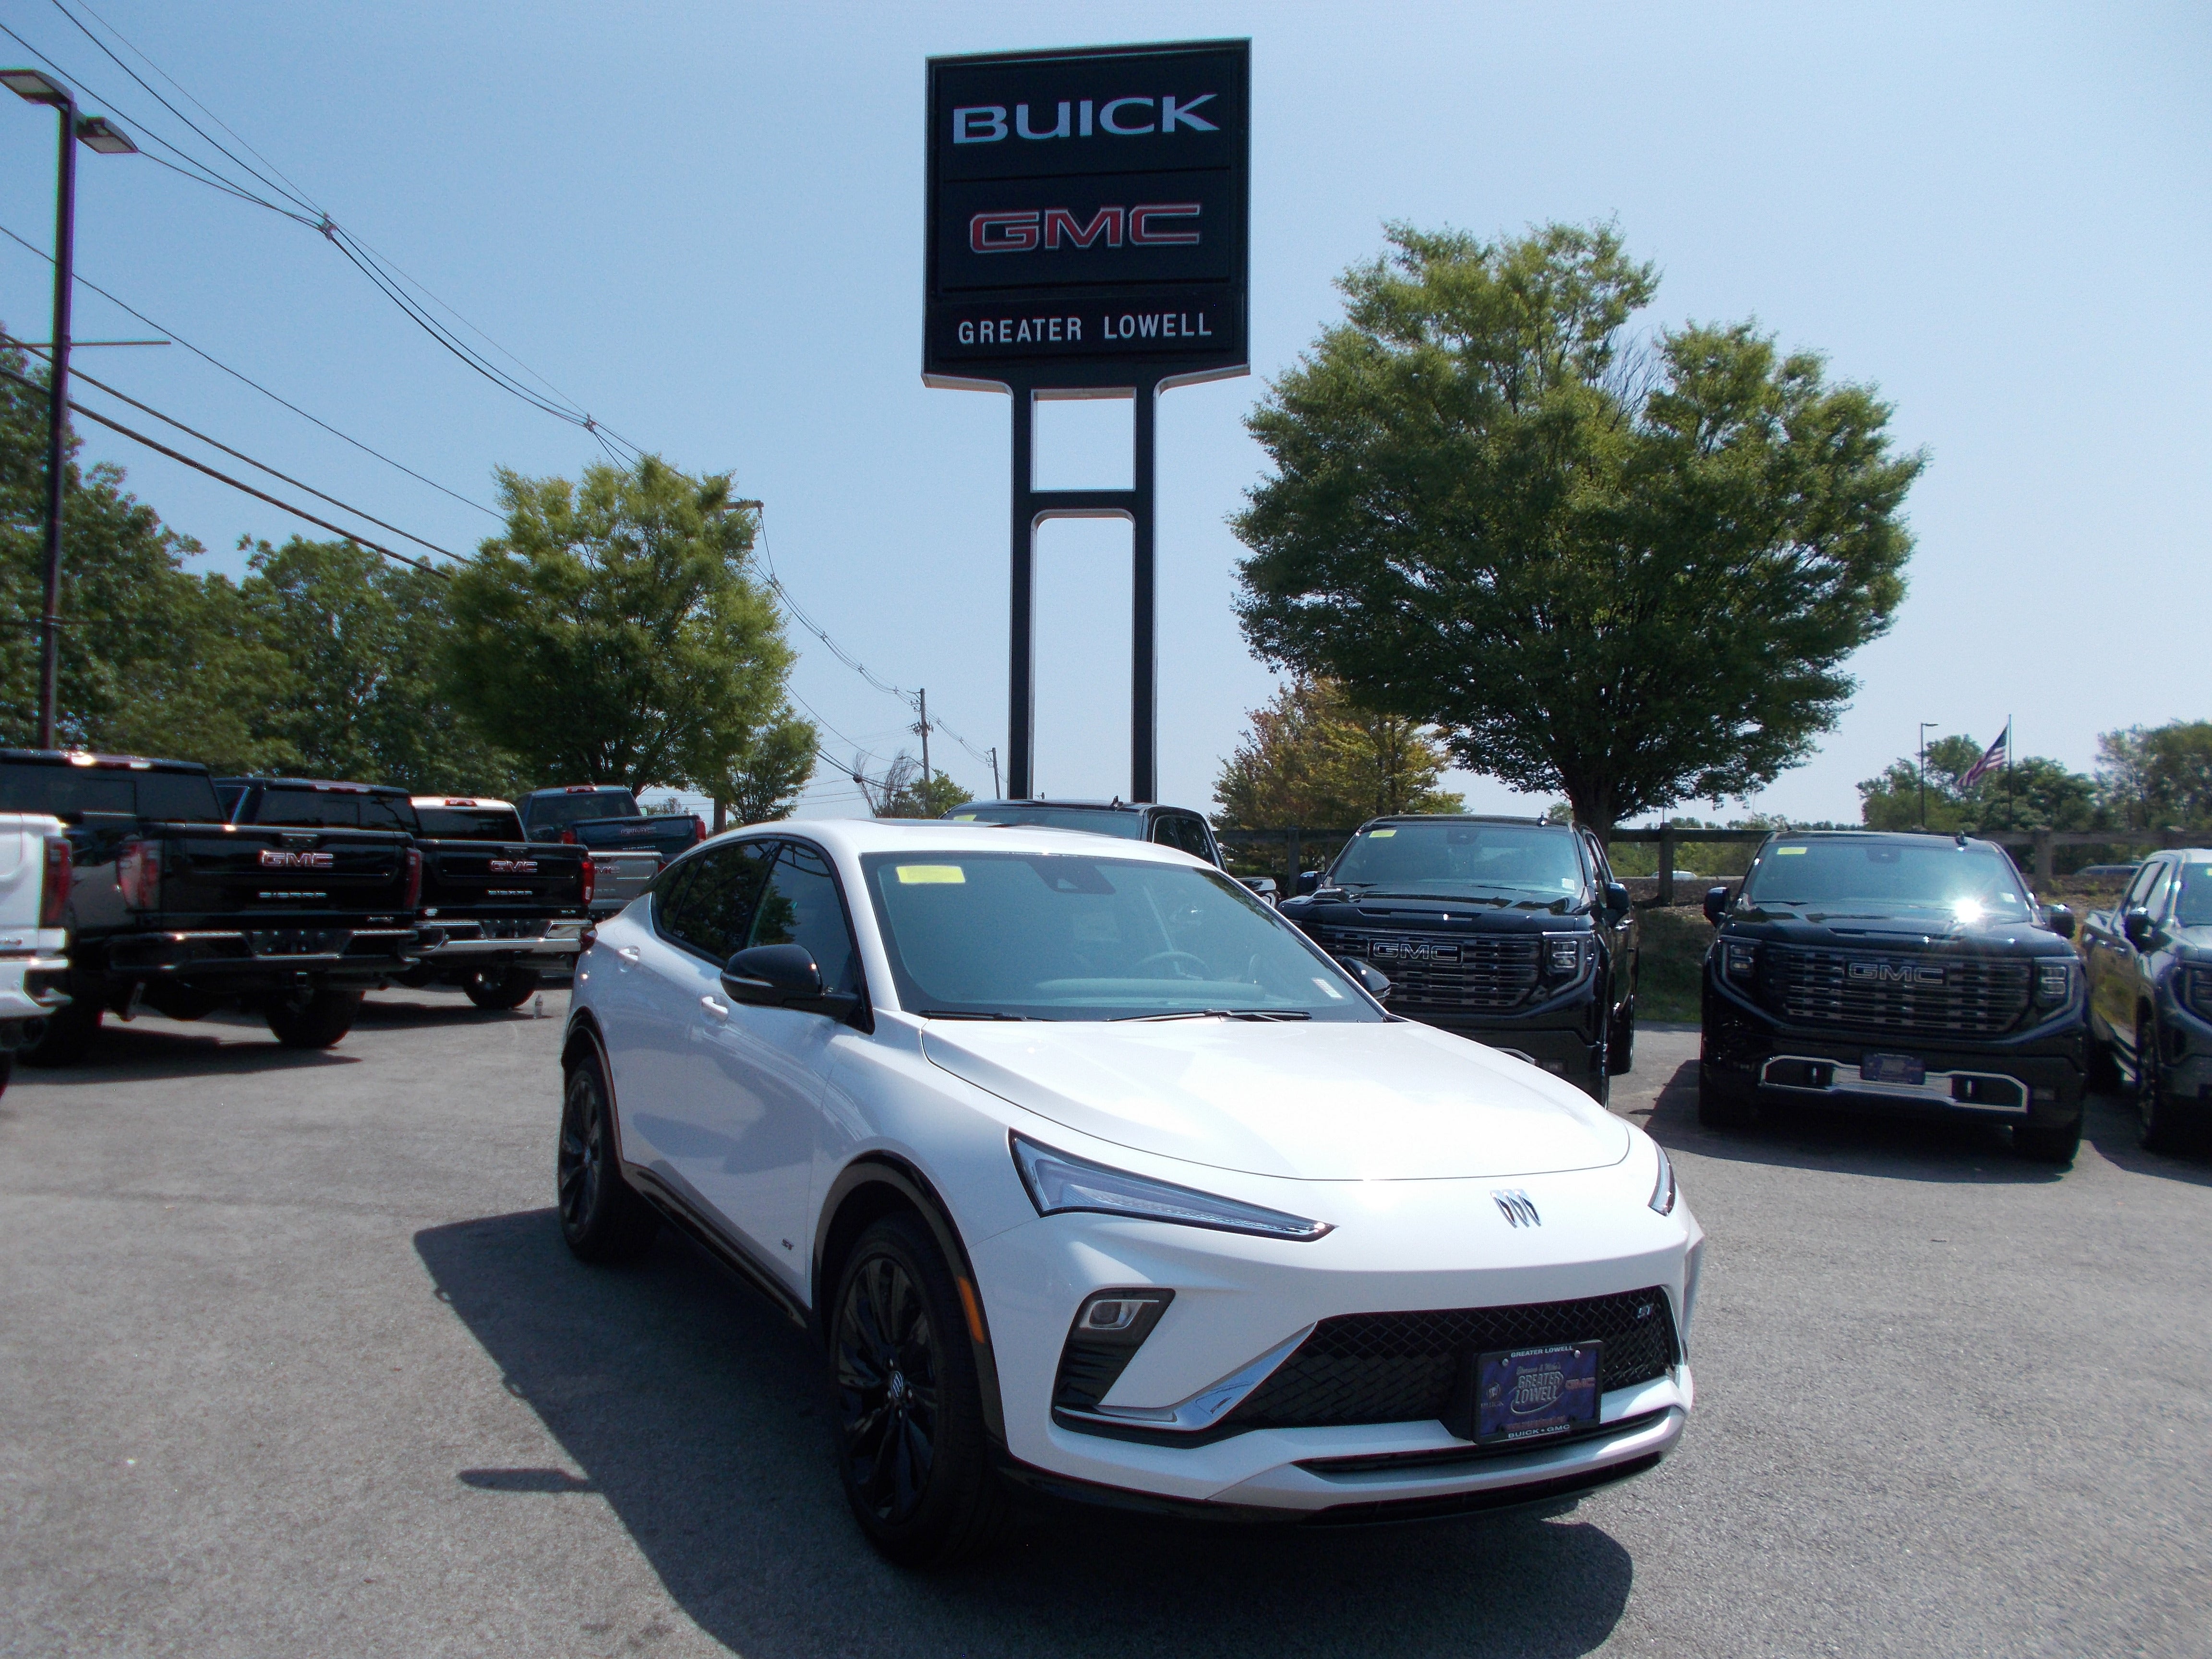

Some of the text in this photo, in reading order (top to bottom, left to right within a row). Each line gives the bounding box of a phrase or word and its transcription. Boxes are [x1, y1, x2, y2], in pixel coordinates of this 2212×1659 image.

[953, 94, 1220, 144] BUICK
[970, 203, 1201, 253] GMC
[958, 313, 1212, 344] GREATER LOWELL
[261, 851, 334, 867] GMC
[491, 860, 538, 872] GMC
[1373, 942, 1457, 961] GMC
[1849, 963, 1943, 984] GMC
[1511, 1348, 1543, 1358] GREATER
[1517, 1371, 1560, 1389] GREATER
[1515, 1385, 1557, 1404] LOWELL
[1508, 1429, 1539, 1439] BUICK
